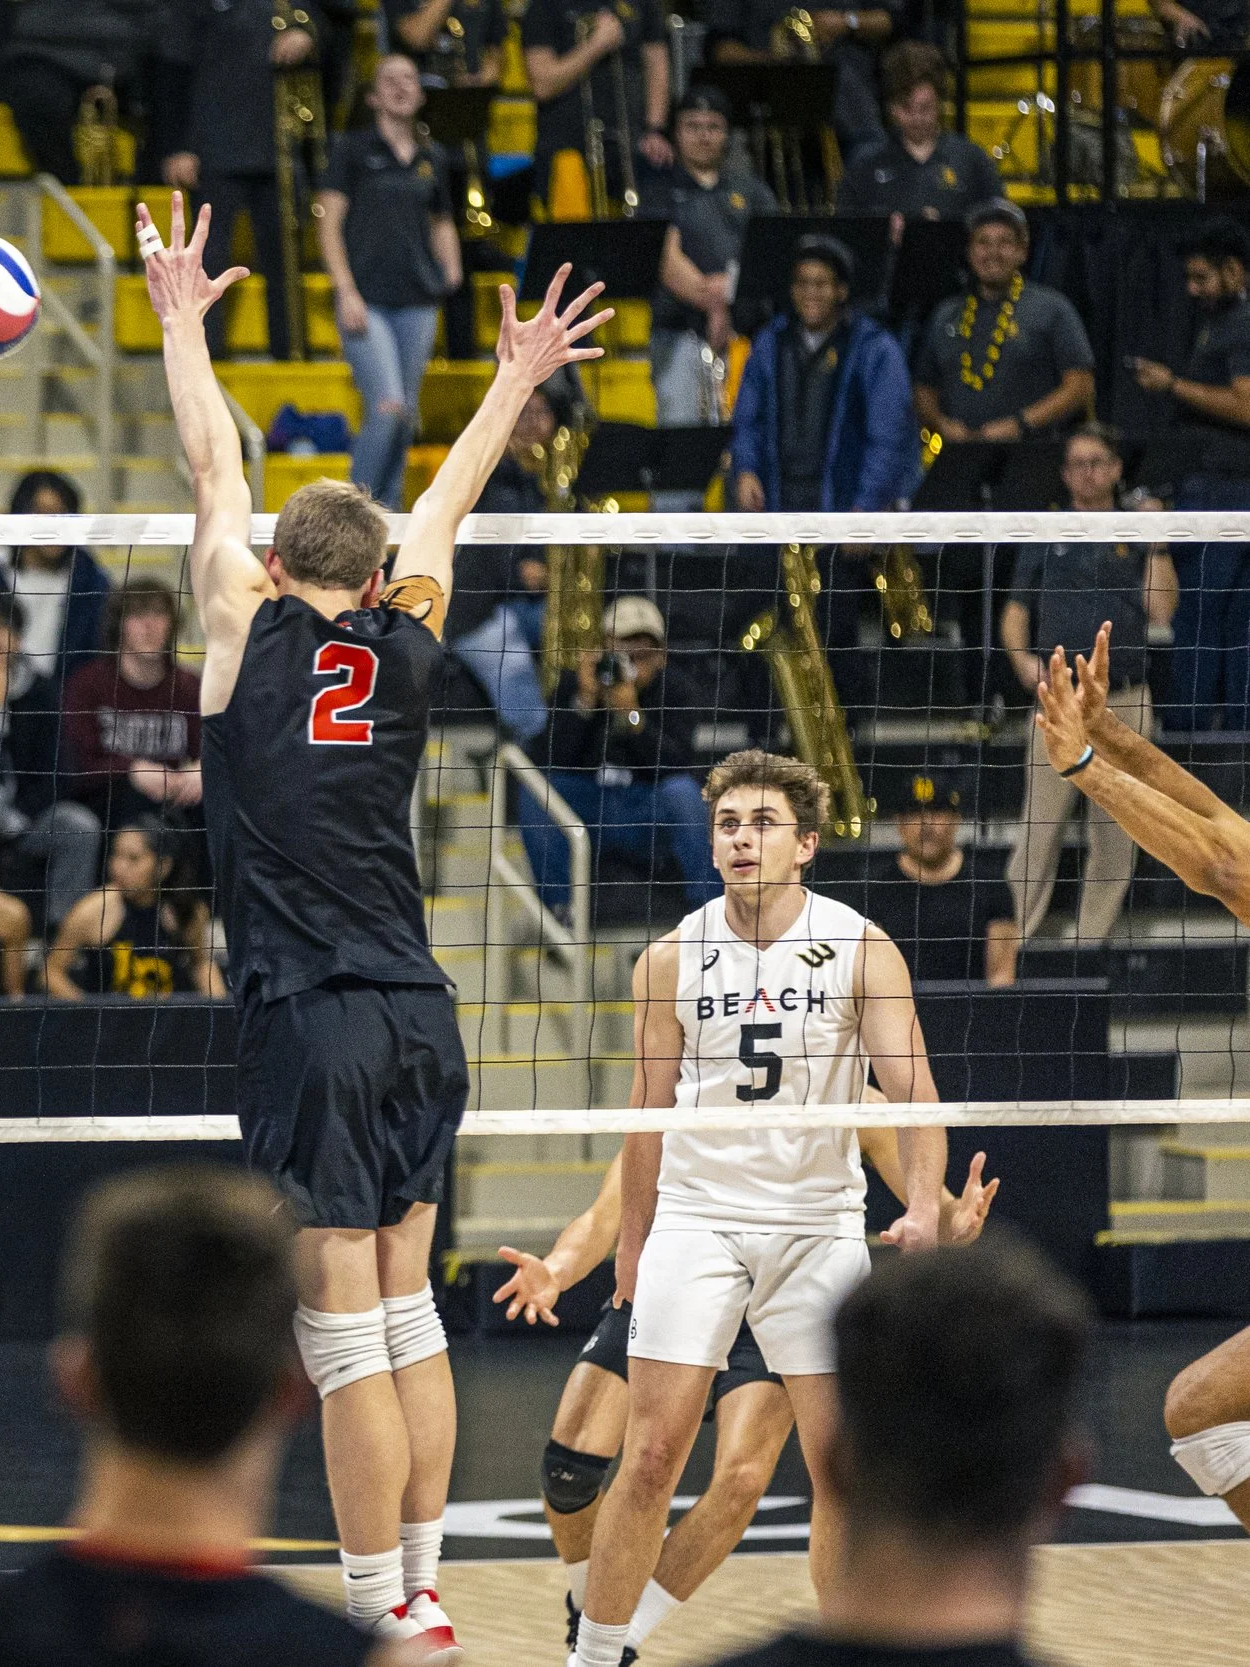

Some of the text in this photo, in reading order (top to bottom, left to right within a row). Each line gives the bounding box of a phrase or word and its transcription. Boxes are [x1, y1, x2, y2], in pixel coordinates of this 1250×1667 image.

[308, 640, 379, 745] 2
[696, 987, 825, 1021] BEACH
[735, 1022, 783, 1102] 5
